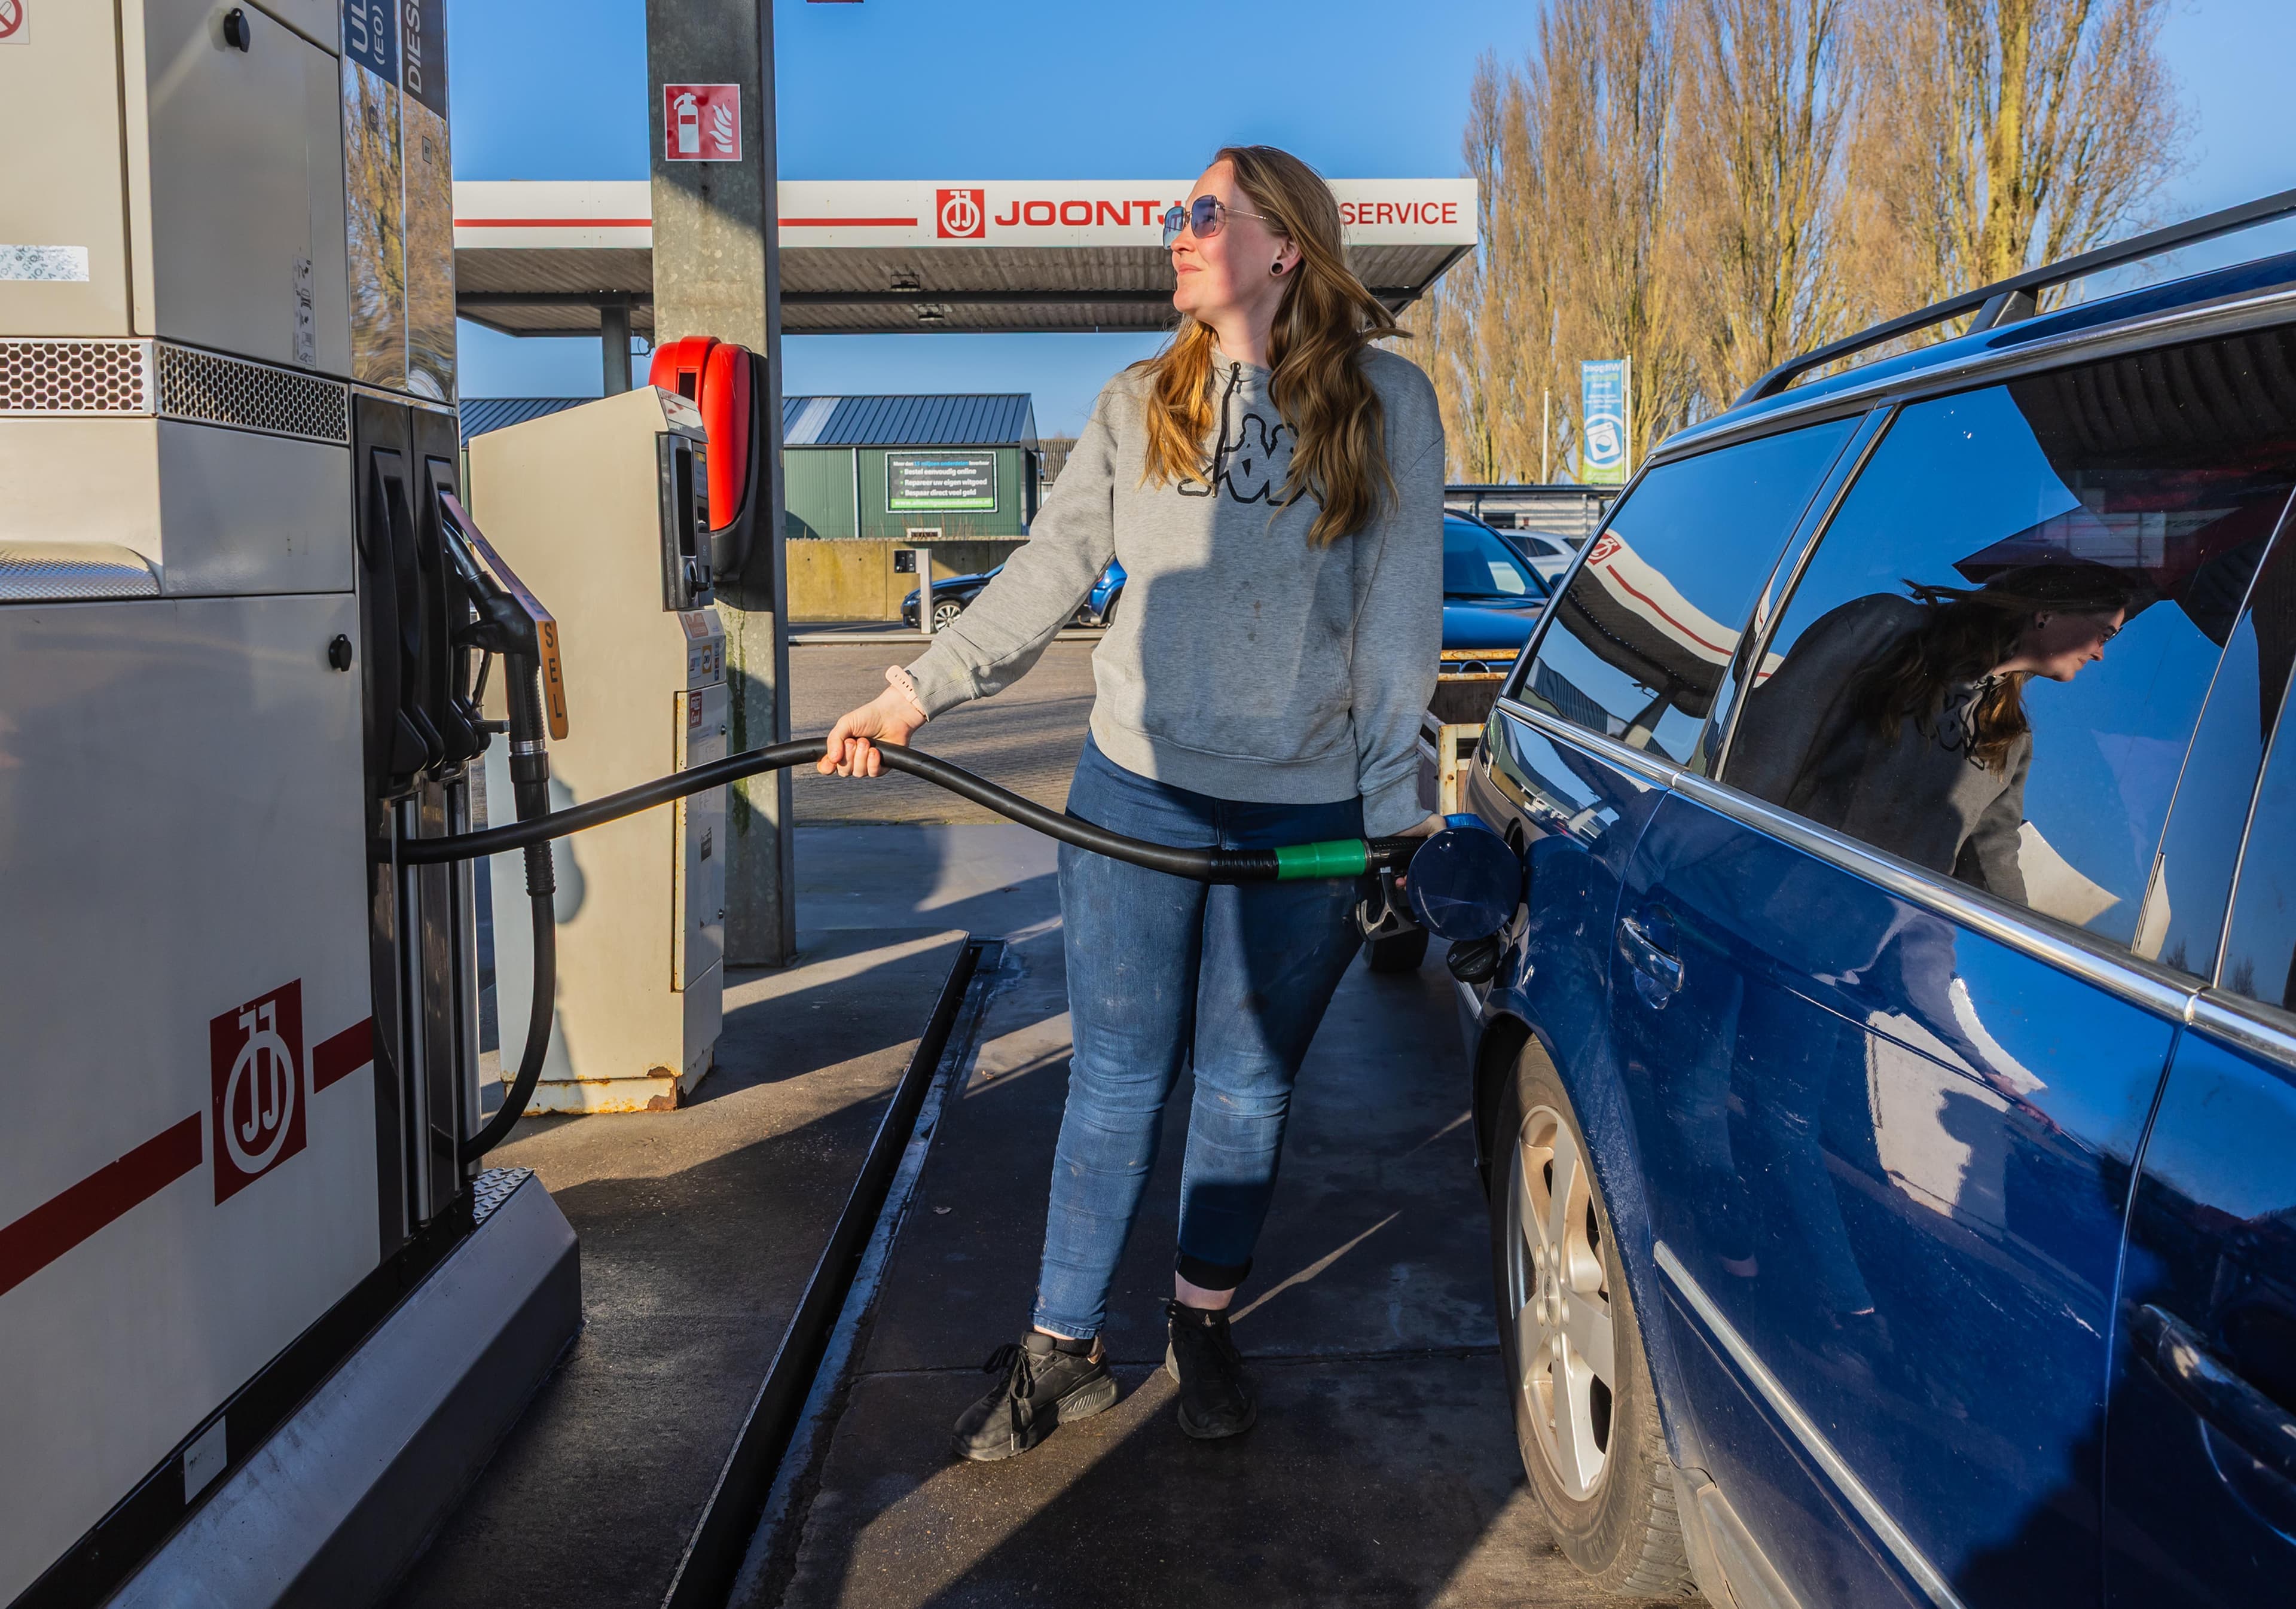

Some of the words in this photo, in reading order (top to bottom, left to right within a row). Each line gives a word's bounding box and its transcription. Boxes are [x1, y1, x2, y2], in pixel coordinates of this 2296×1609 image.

[1339, 202, 1458, 225] SERVICE
[961, 478, 988, 486] witgoed
[962, 488, 976, 497] geld
